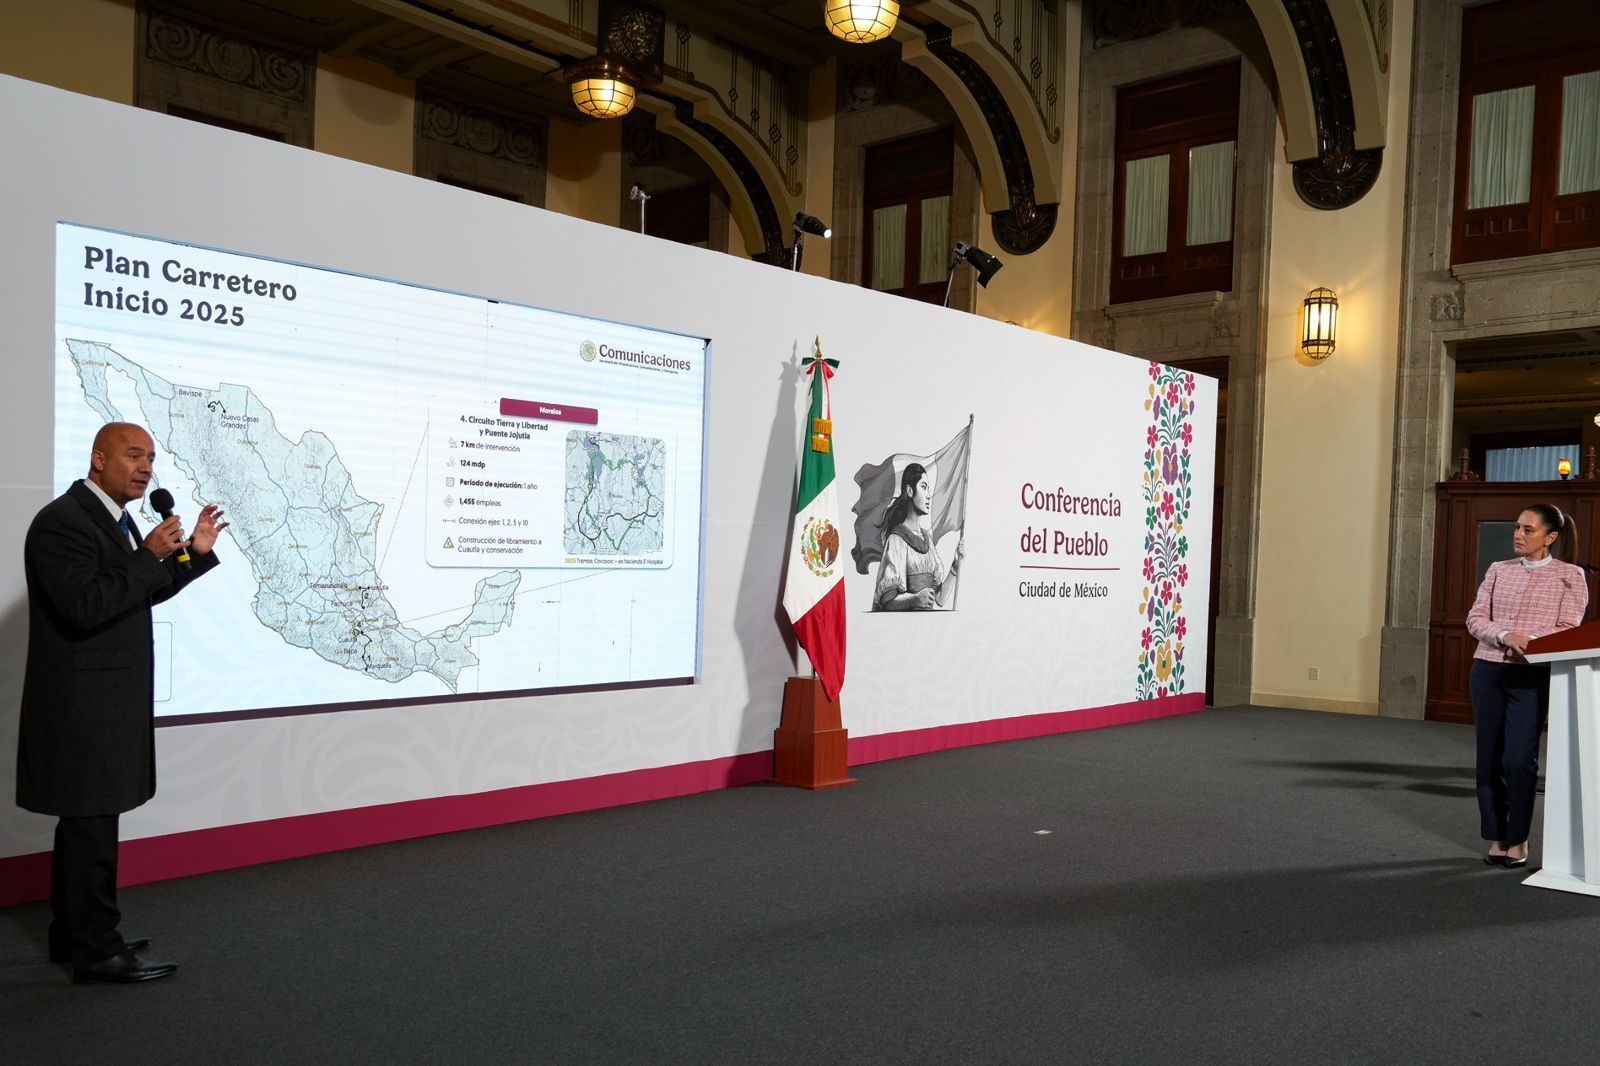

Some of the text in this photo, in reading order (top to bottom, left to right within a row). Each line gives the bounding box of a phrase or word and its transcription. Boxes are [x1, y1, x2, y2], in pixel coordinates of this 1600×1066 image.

[84, 246, 297, 301] Plan Carretero
[84, 282, 244, 326] Inicio 2025
[599, 344, 691, 370] Comunicaciones
[179, 388, 202, 398] Bavispe
[540, 407, 562, 415] Morelos
[221, 414, 241, 422] Nuevo
[469, 416, 495, 426] Circuito
[496, 419, 515, 428] Tierra
[522, 422, 548, 431] Libertad
[221, 421, 247, 430] Grandes
[485, 428, 508, 438] Puente
[509, 429, 530, 440] Jojutla
[485, 443, 520, 452] intervención
[494, 481, 522, 489] ejecución:
[1021, 483, 1121, 517] Conferencia
[458, 536, 496, 544] Construcción
[1020, 526, 1108, 556] del Pueblo
[1019, 581, 1108, 598] Ciudad de México
